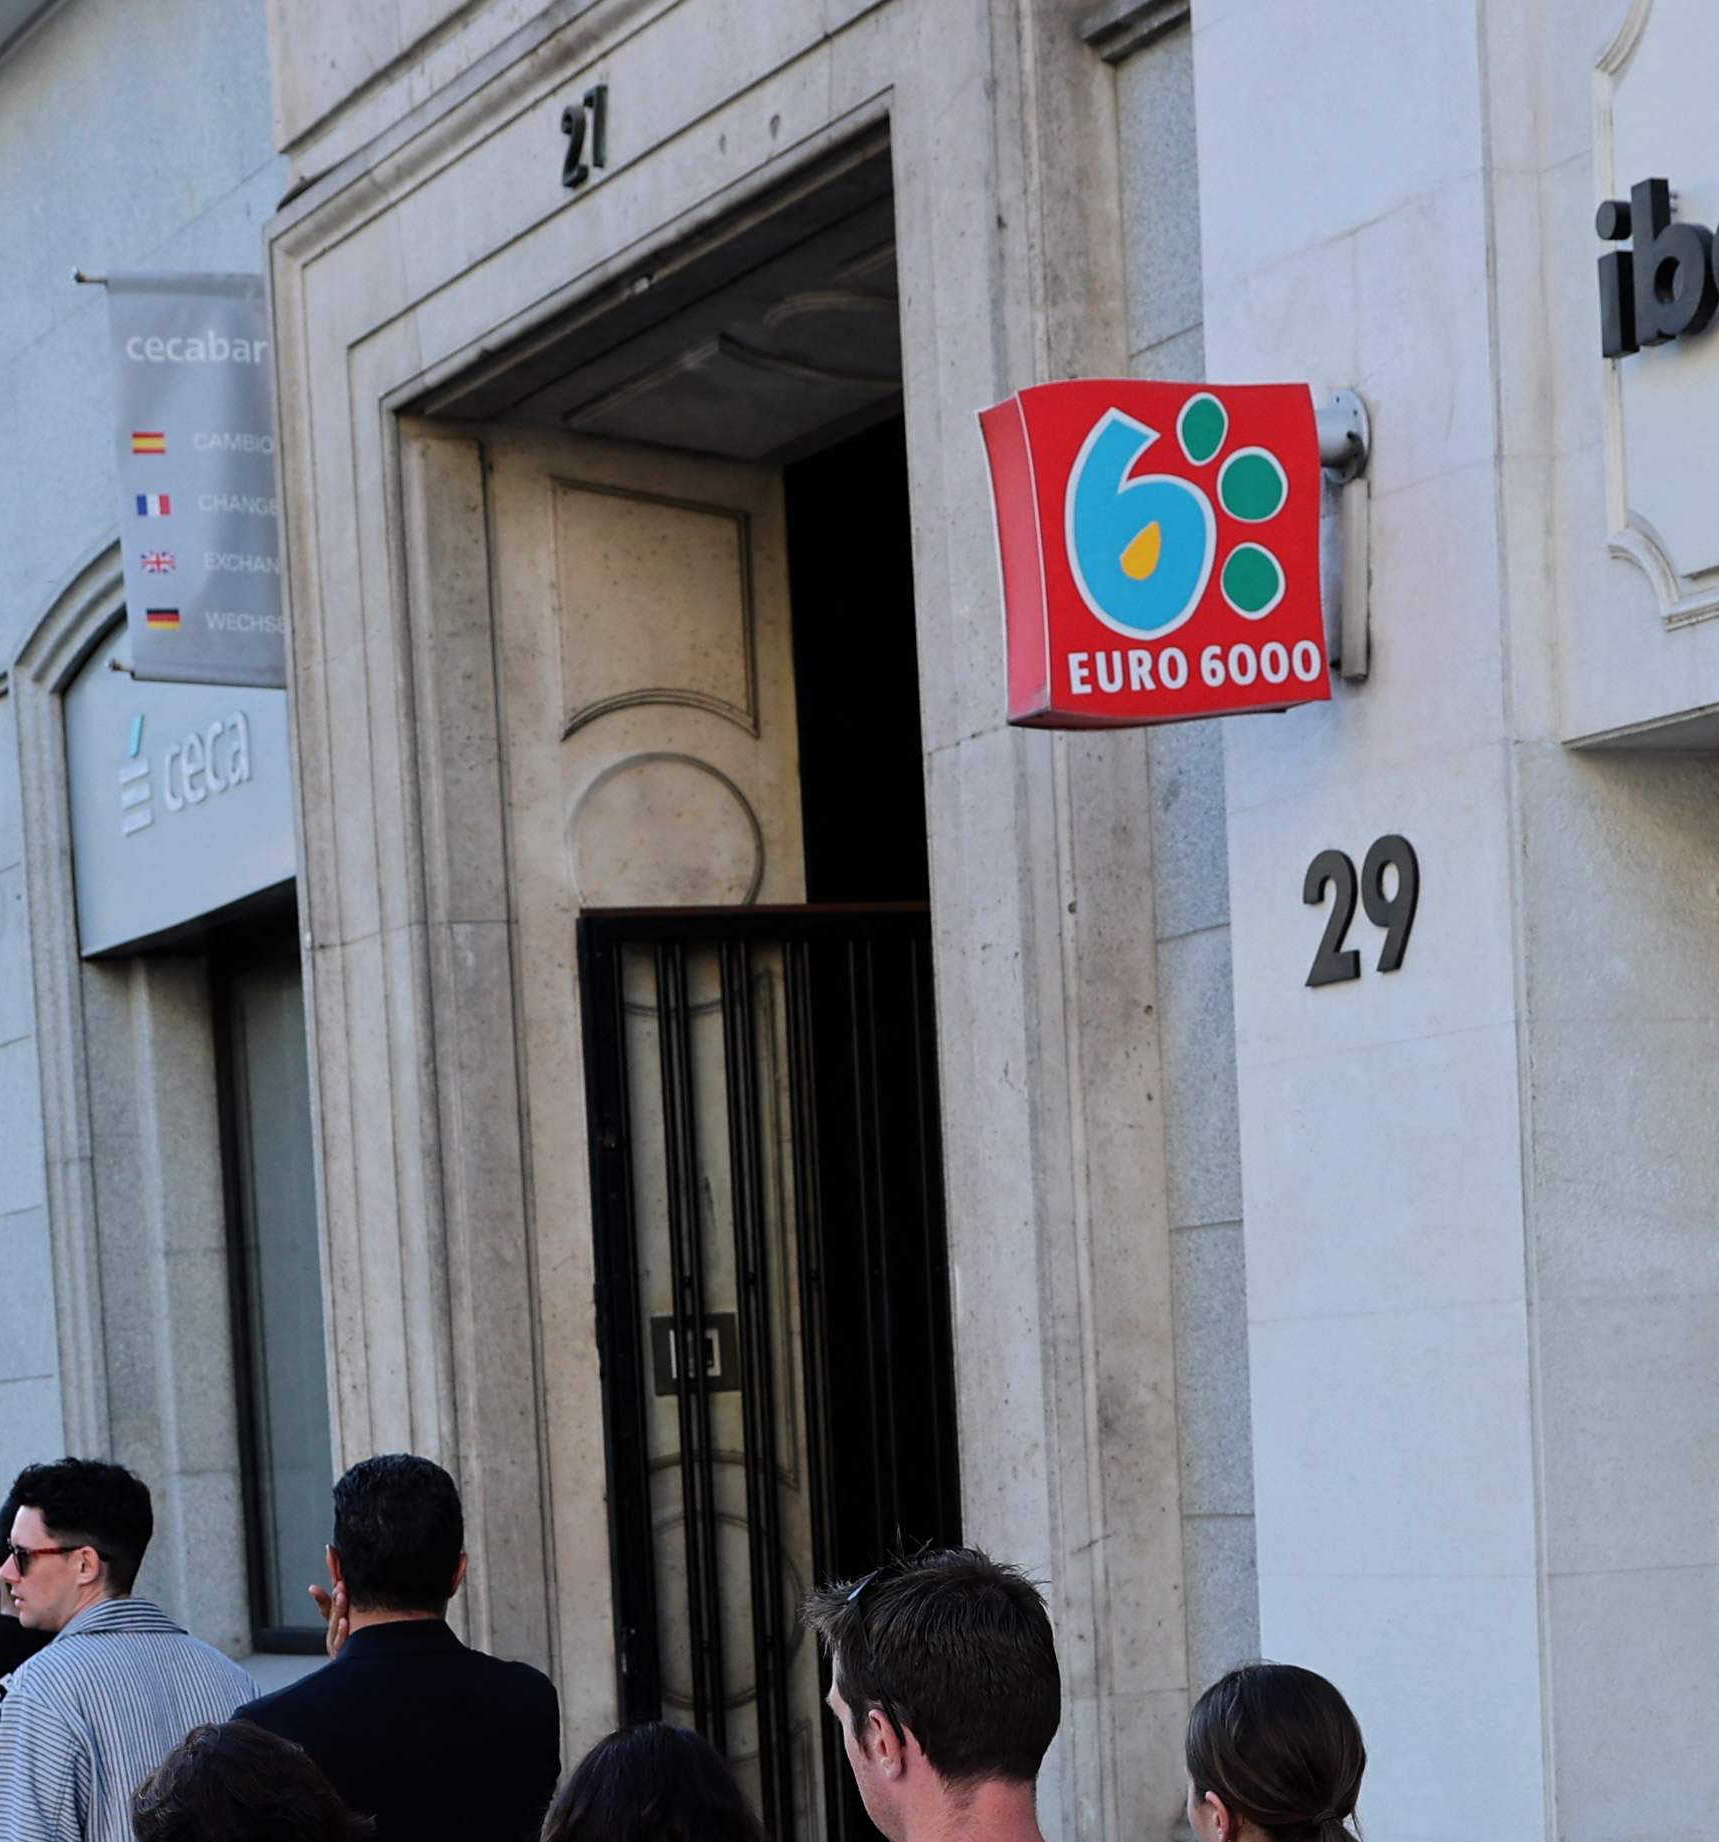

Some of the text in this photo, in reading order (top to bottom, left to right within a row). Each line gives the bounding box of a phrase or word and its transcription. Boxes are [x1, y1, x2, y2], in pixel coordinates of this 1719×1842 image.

[193, 432, 275, 455] CAMBIO
[203, 551, 281, 574] EXCHAN
[1067, 640, 1321, 695] EURO 6000
[165, 711, 252, 812] ceca
[1303, 834, 1420, 987] 29
